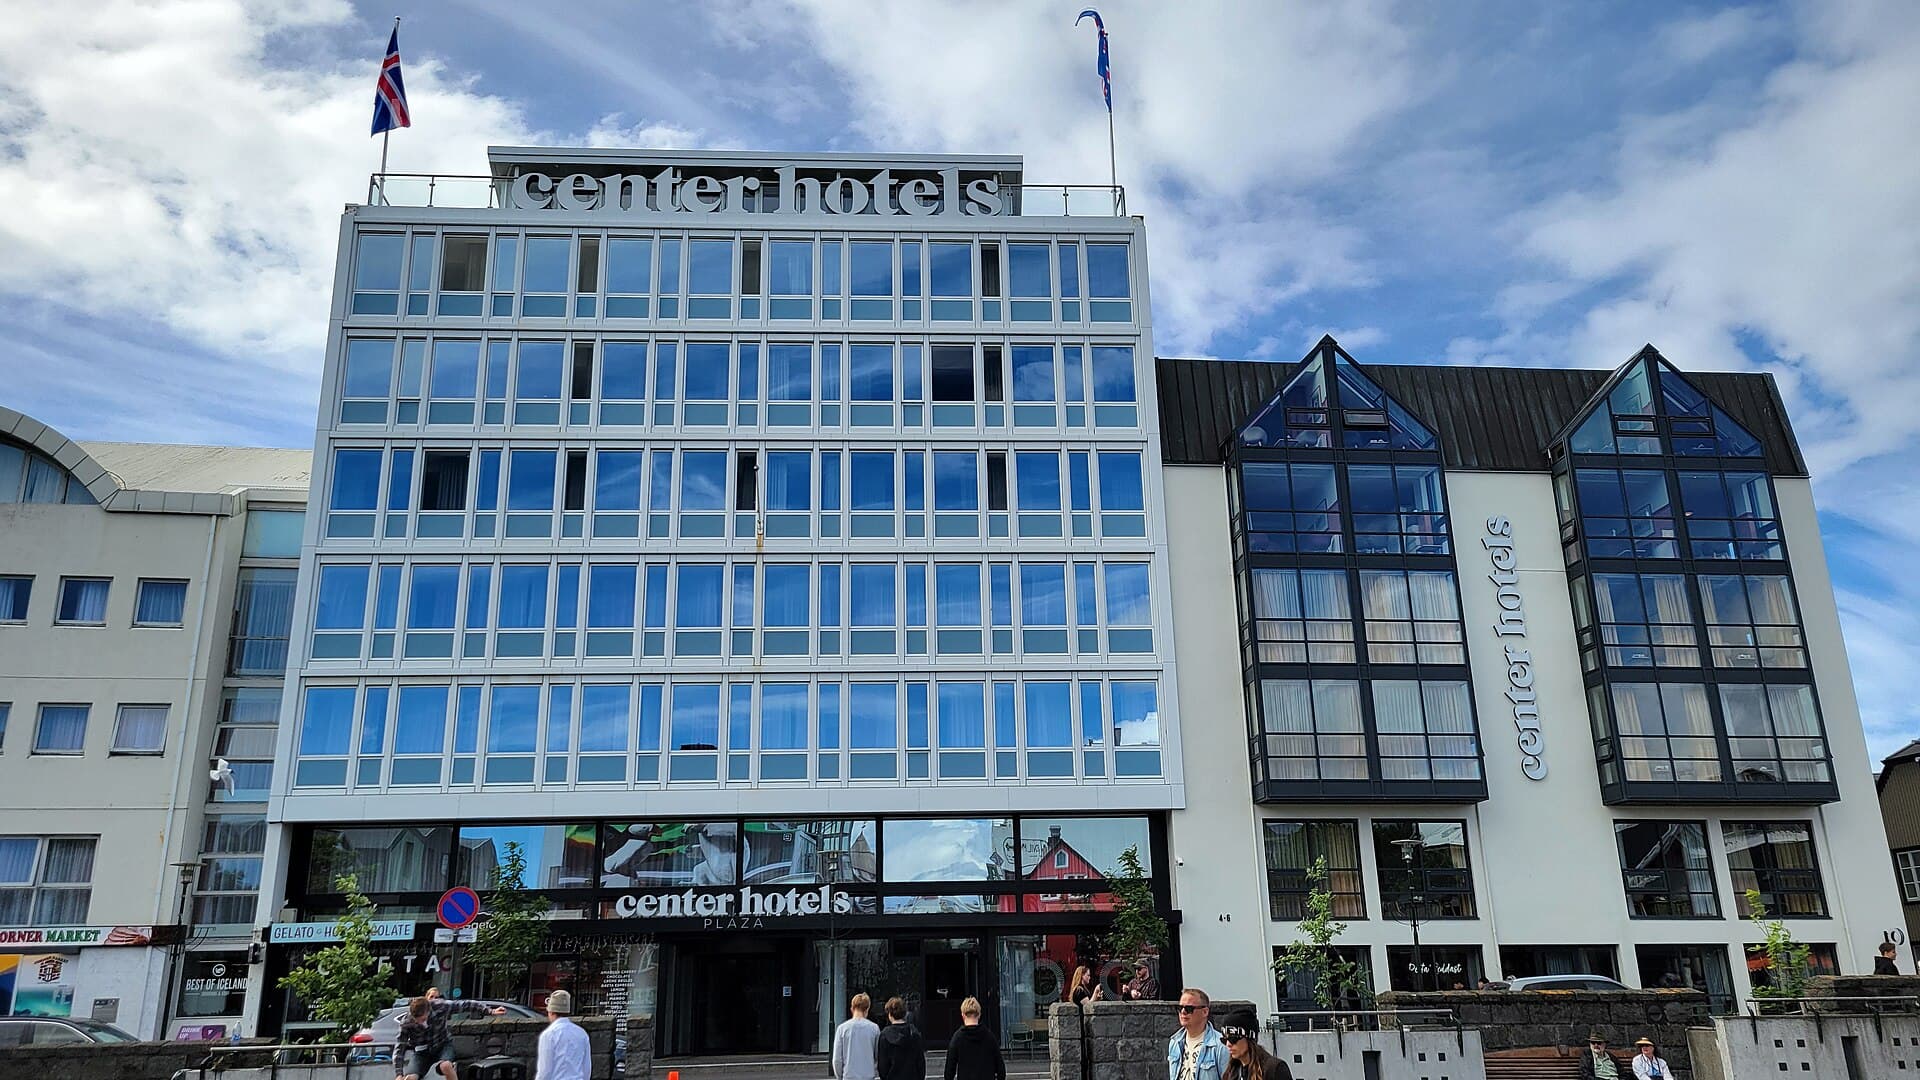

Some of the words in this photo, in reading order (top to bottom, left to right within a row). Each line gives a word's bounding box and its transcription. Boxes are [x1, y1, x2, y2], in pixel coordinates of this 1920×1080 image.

[511, 166, 761, 213] center
[773, 164, 1003, 217] hotels
[1481, 514, 1527, 639] hotels
[1503, 642, 1548, 781] center
[615, 887, 735, 918] center
[739, 884, 851, 917] hotels
[274, 926, 314, 939] GELATO
[324, 925, 343, 937] HO
[703, 917, 764, 929] PLAZA
[0, 930, 43, 944] ORNER
[45, 929, 101, 944] MARKET
[186, 979, 205, 991] BEST
[205, 979, 217, 990] OF
[217, 977, 249, 990] ICELAND
